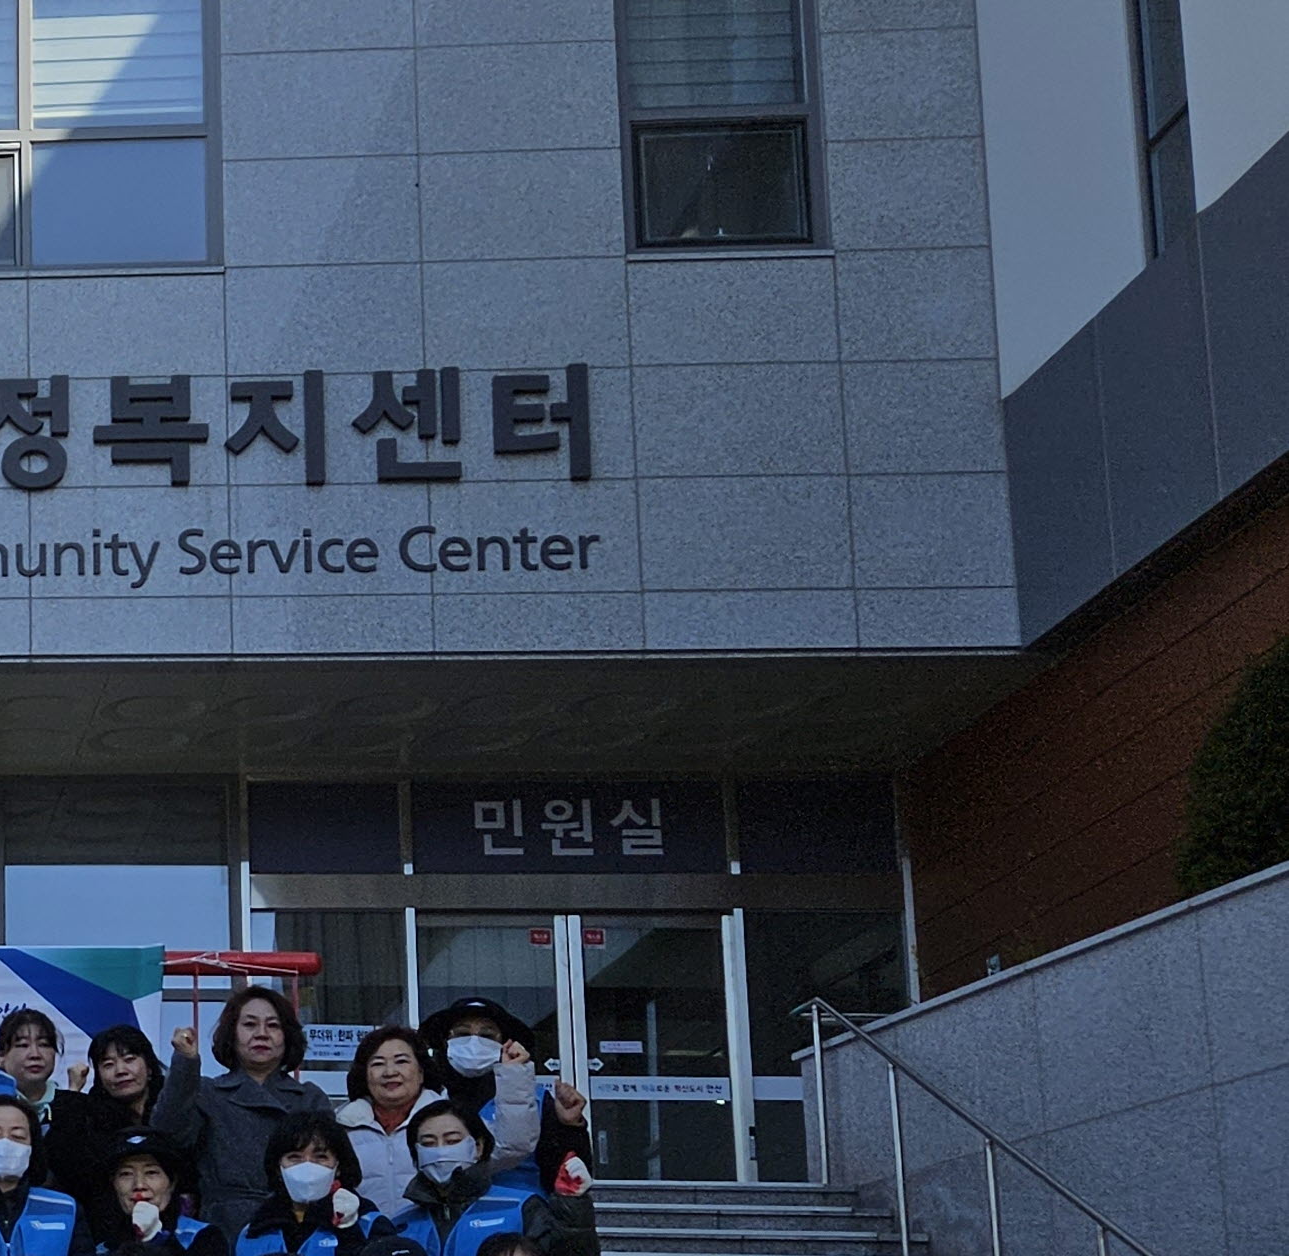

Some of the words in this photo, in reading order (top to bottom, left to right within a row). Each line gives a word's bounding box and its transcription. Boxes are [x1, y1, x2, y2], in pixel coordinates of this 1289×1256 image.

[177, 528, 379, 576] Service
[398, 525, 601, 573] Center
[474, 799, 664, 856] 민원실
